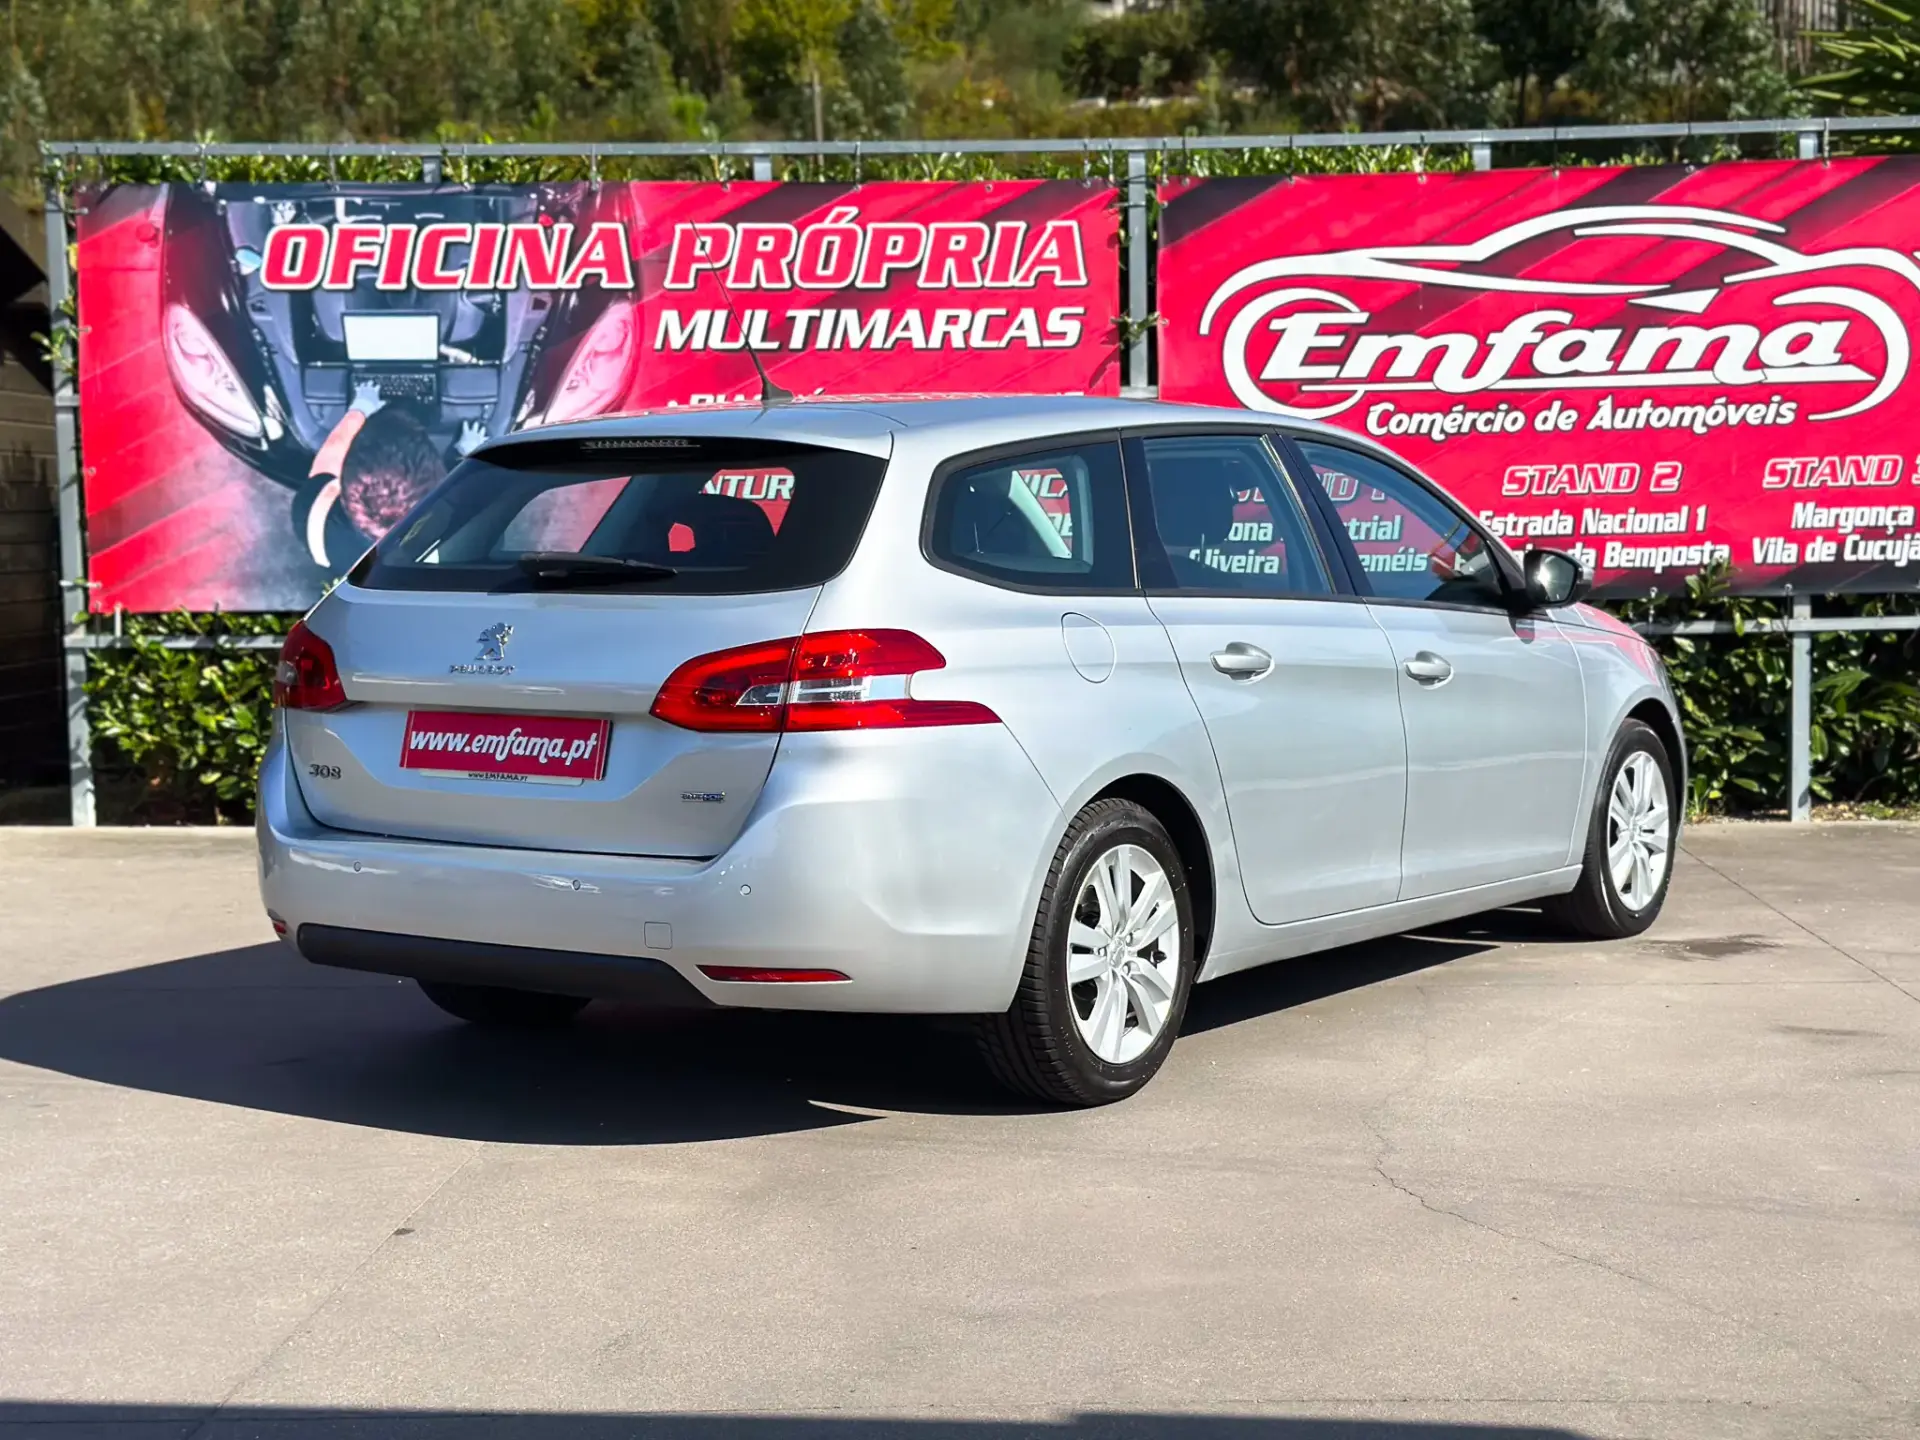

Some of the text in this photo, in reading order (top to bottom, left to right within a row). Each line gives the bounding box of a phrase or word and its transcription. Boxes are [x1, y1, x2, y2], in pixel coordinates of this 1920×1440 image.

[260, 206, 1089, 291] OFICINA PRÓPRIA
[653, 307, 1085, 350] MULTIMARCAS
[1259, 309, 1851, 393] Emfama
[1366, 395, 1798, 442] Comércio de Automóveis
[1501, 462, 1682, 496] STAND 2
[1762, 455, 1903, 488] STAND
[1226, 522, 1274, 541] ona
[1479, 505, 1707, 537] Estrada Nacional 1
[1791, 502, 1915, 534] Margonça
[1602, 541, 1730, 574] Bemposta
[1752, 537, 1799, 564] Vila
[1805, 536, 1837, 562] de
[449, 664, 515, 675] PEUGEOT
[410, 727, 598, 765] www.emfama.pt
[309, 763, 342, 780] 308
